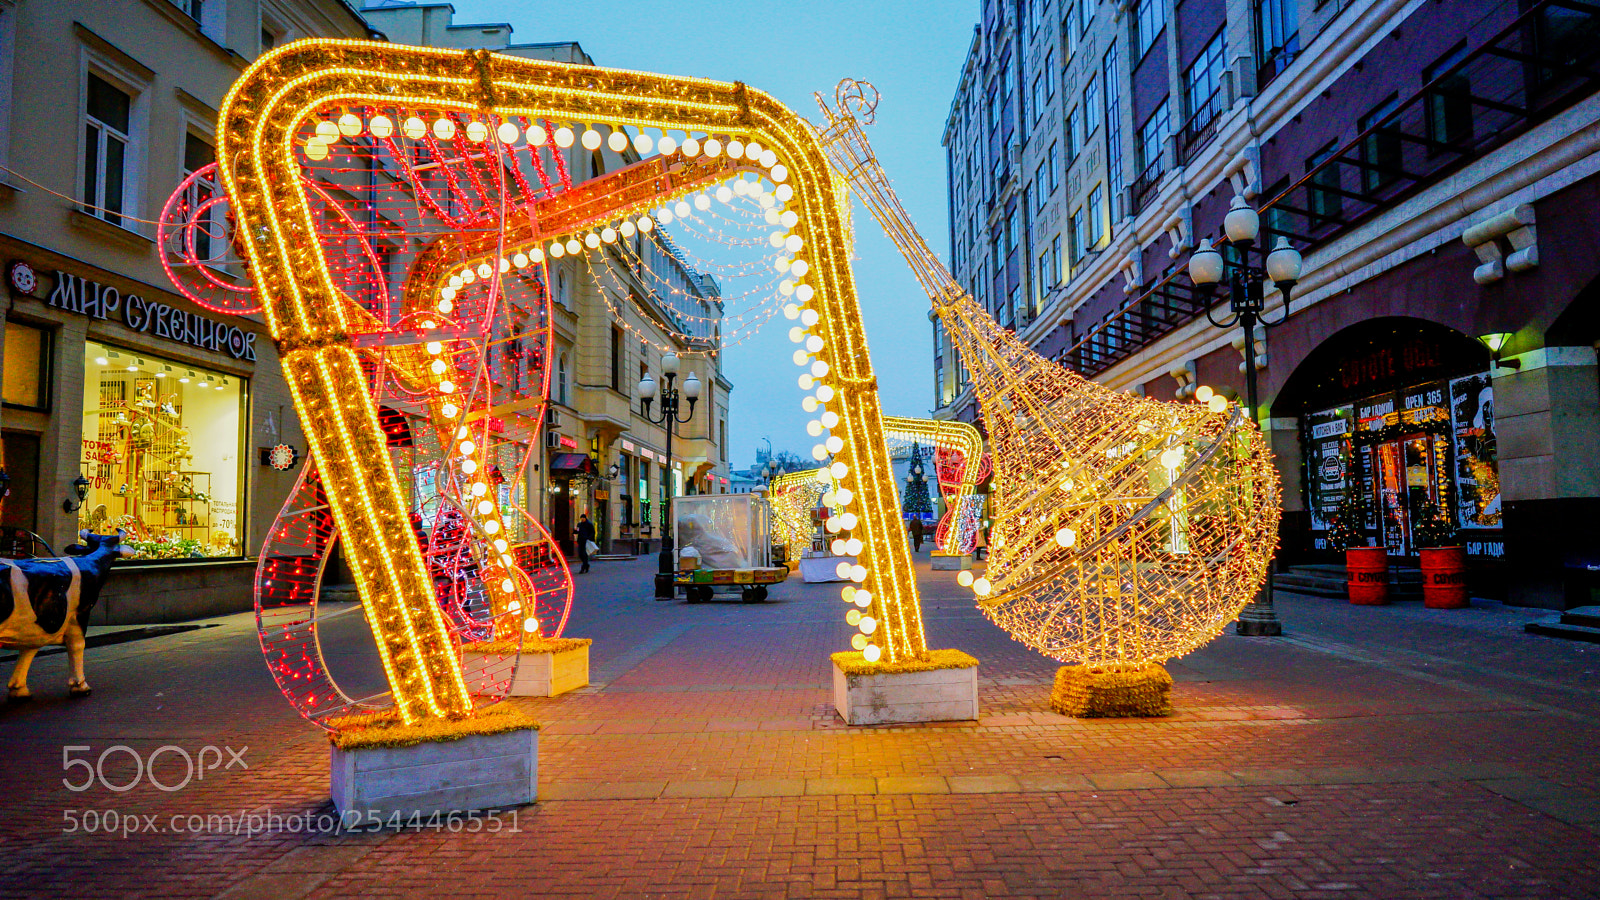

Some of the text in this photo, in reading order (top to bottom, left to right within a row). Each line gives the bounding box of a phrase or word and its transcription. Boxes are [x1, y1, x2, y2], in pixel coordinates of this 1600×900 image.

[49, 270, 257, 361] МИР СУВЕНИРОВ
[1405, 389, 1442, 409] OPEN 365
[1466, 541, 1482, 555] БАР
